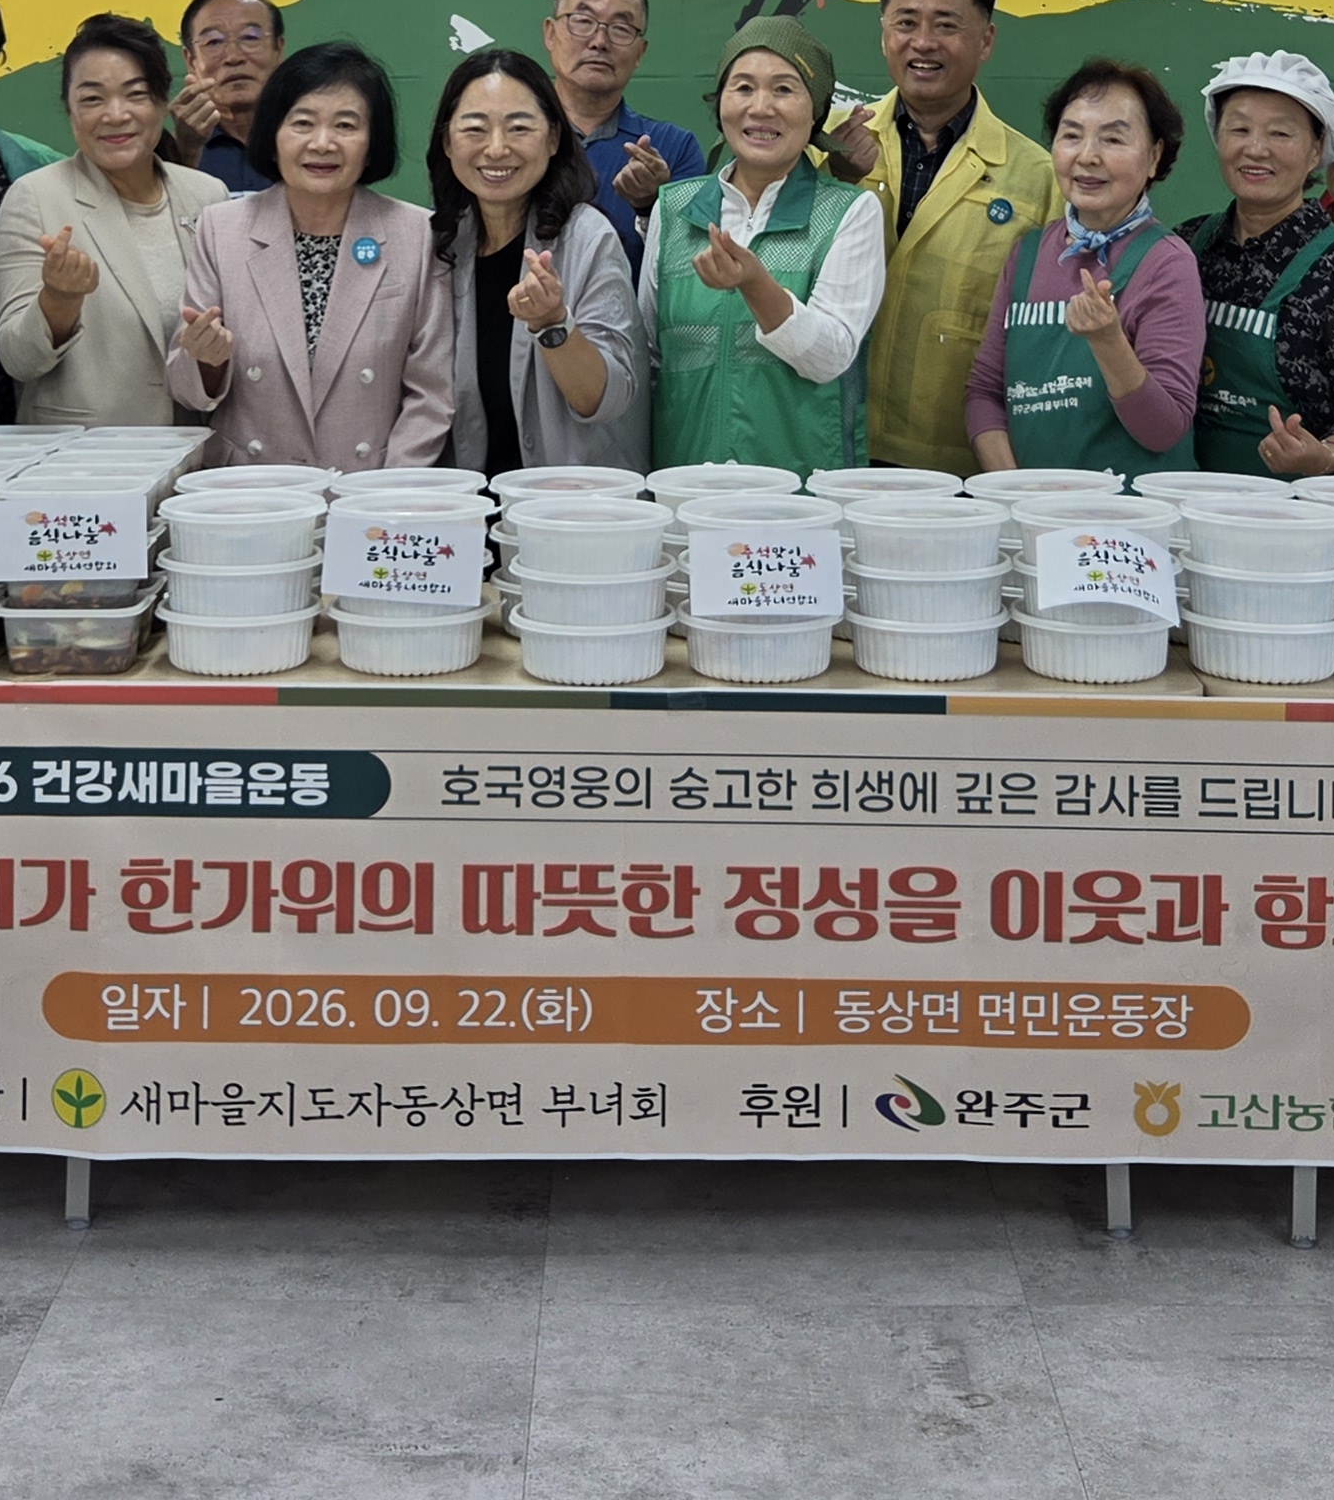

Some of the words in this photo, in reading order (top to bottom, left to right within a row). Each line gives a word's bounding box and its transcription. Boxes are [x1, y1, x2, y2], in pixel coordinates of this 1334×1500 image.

[38, 513, 100, 528] 추석맞이
[28, 527, 99, 546] 음식나눔
[377, 529, 440, 547] 추석맞이
[1086, 535, 1145, 556] 추석맞이
[366, 545, 438, 567] 음식나눔
[740, 544, 802, 559] 추석맞이
[1077, 550, 1146, 575] 음식나눔
[731, 558, 801, 578] 음식나눔
[32, 759, 330, 806] 건강새마을운동
[440, 764, 653, 810] 호국영웅의
[668, 767, 797, 812] 숭고한
[811, 769, 938, 815] 희생에
[955, 772, 1038, 815] 깊은
[1054, 774, 1182, 819] 감사를
[119, 858, 435, 935] 한가위의
[461, 862, 701, 938] 따뜻한
[724, 865, 962, 943] 정성을
[990, 868, 1231, 947] 이웃과
[101, 983, 187, 1031] 일자
[239, 987, 357, 1028] 2026.
[373, 987, 440, 1028] 09.
[457, 986, 594, 1033] 22.(화)
[695, 987, 782, 1035] 장소
[833, 990, 961, 1035] 동상면
[978, 991, 1194, 1039] 면민운동장
[120, 1080, 526, 1128] 새마을지도자동상면
[542, 1081, 669, 1129] 부녀회
[739, 1082, 822, 1130] 후원
[954, 1088, 1092, 1131] 완주군
